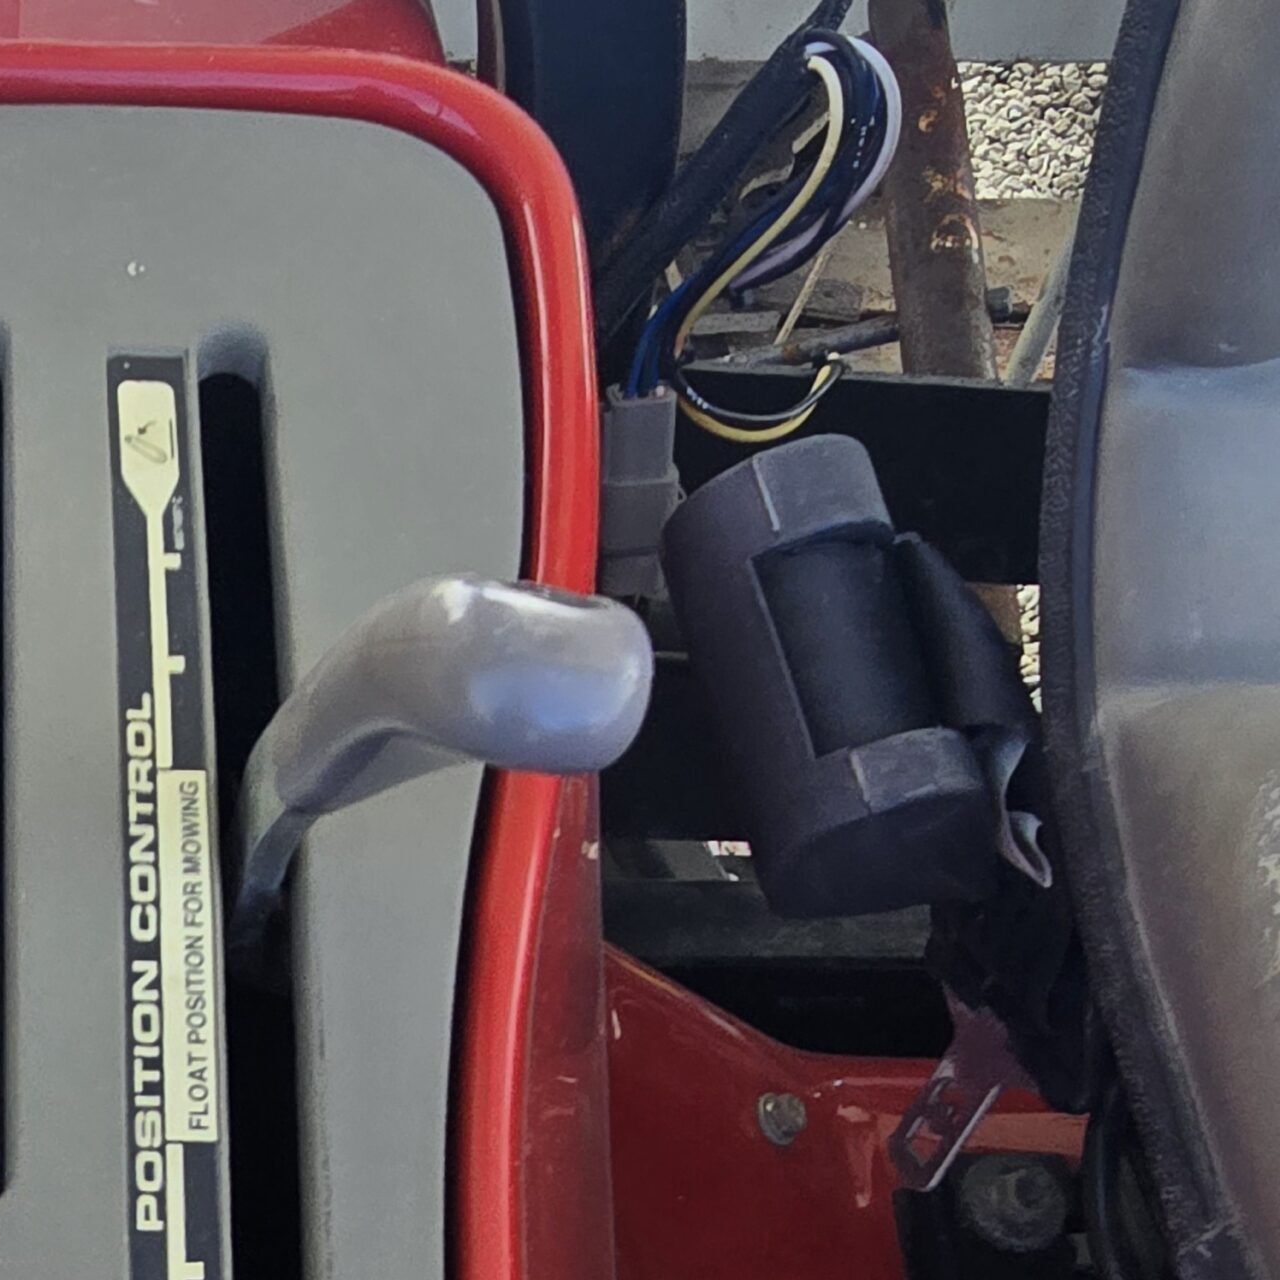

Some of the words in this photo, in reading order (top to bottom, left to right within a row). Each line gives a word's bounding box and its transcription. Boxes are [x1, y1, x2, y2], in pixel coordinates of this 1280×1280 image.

[126, 692, 158, 942] CONTROL
[179, 780, 201, 874] MOWING
[183, 881, 204, 928] FOR
[184, 935, 207, 1045] POSITION
[131, 960, 164, 1232] POSITION
[188, 1052, 209, 1131] FLOAT
